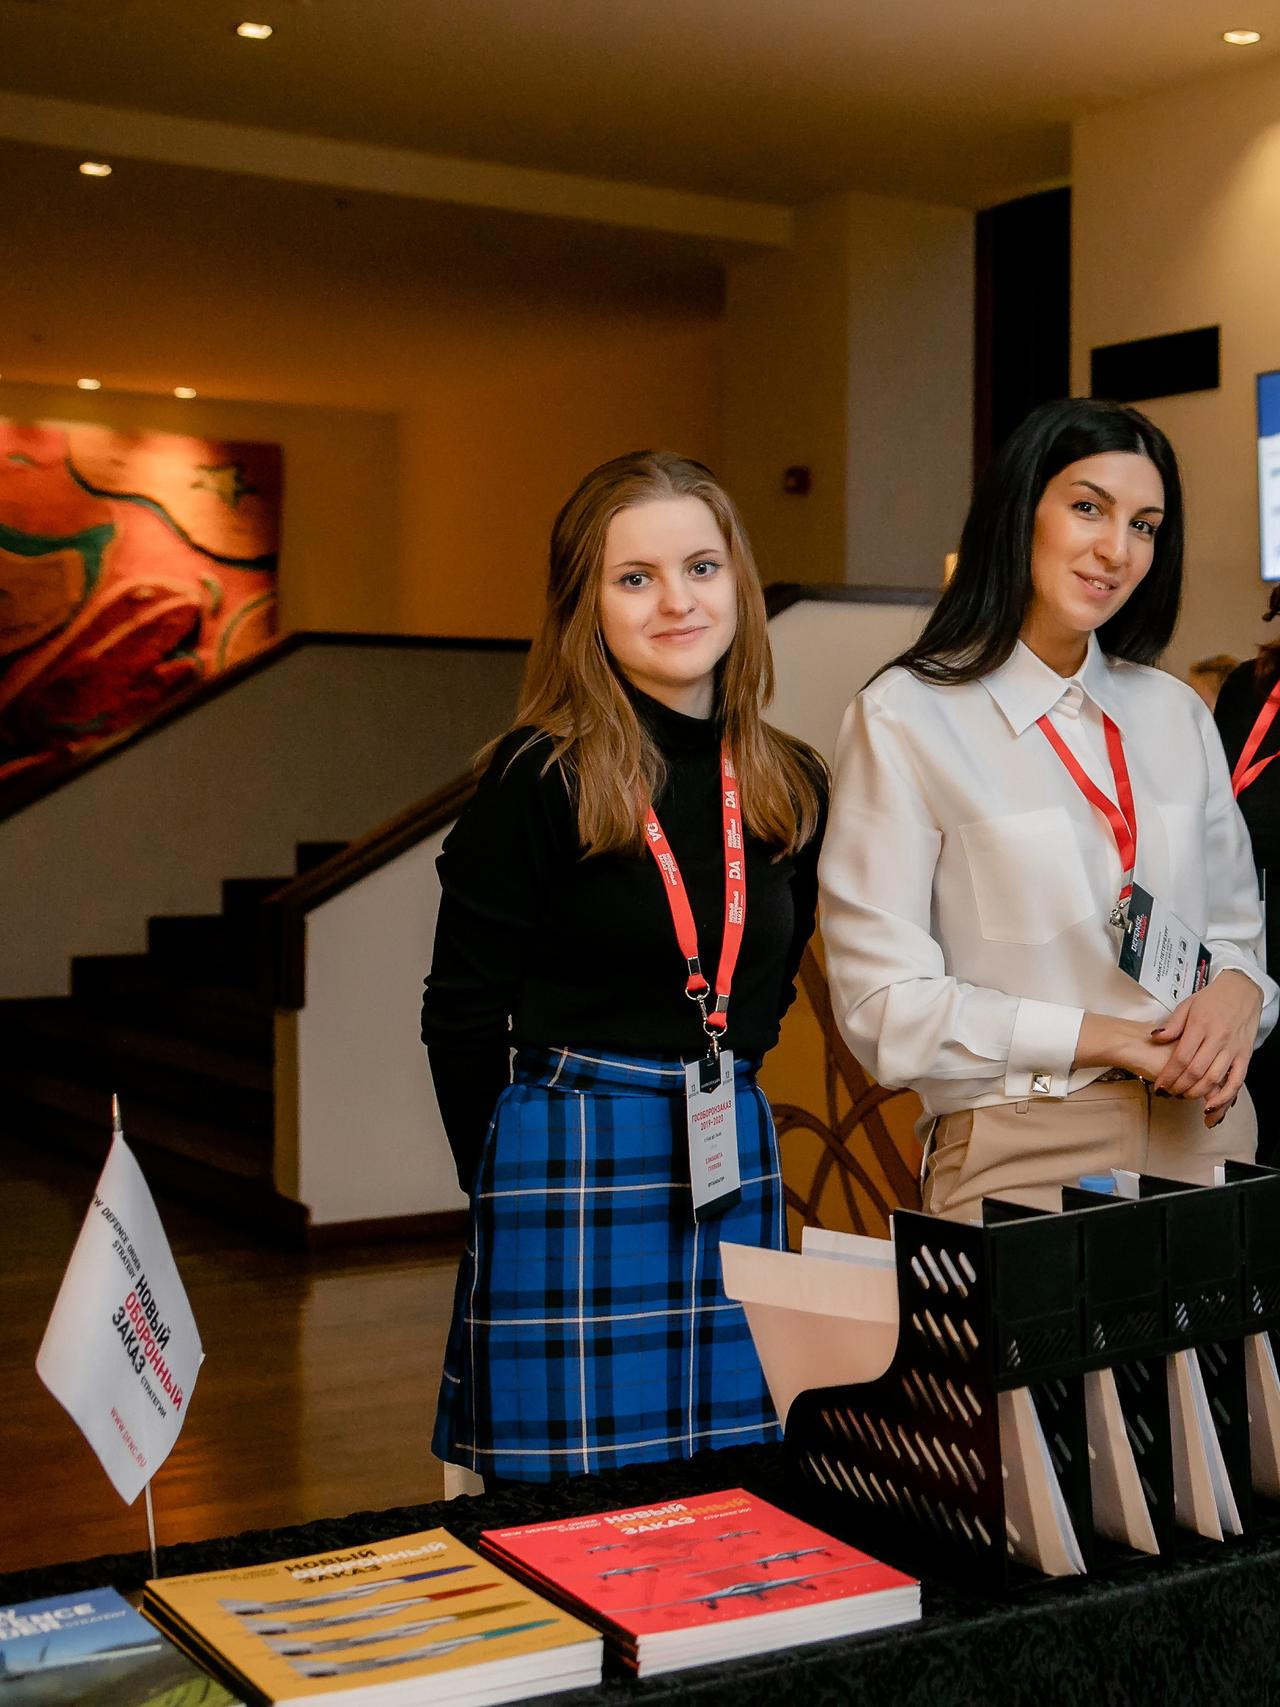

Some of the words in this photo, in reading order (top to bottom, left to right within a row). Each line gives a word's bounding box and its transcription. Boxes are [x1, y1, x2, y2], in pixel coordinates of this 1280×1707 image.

[728, 860, 741, 880] DA
[101, 1207, 130, 1245] DEFENCE
[127, 1243, 141, 1272] ORDER
[112, 1239, 136, 1280] STRATEGY
[135, 1273, 170, 1350] НОВЫЙ
[111, 1305, 146, 1374] ЗАКАЗ
[124, 1291, 183, 1412] ОБОРОННЫЙ
[140, 1375, 167, 1418] СТРАТЕГИИ
[110, 1406, 148, 1468] WWW.DFNC.RU
[603, 1503, 688, 1526] НОВЫЙ
[620, 1516, 696, 1536] ЗАКАЗ
[284, 1549, 377, 1573] НОВЫЙ
[300, 1564, 383, 1585] ЗАКАЗ
